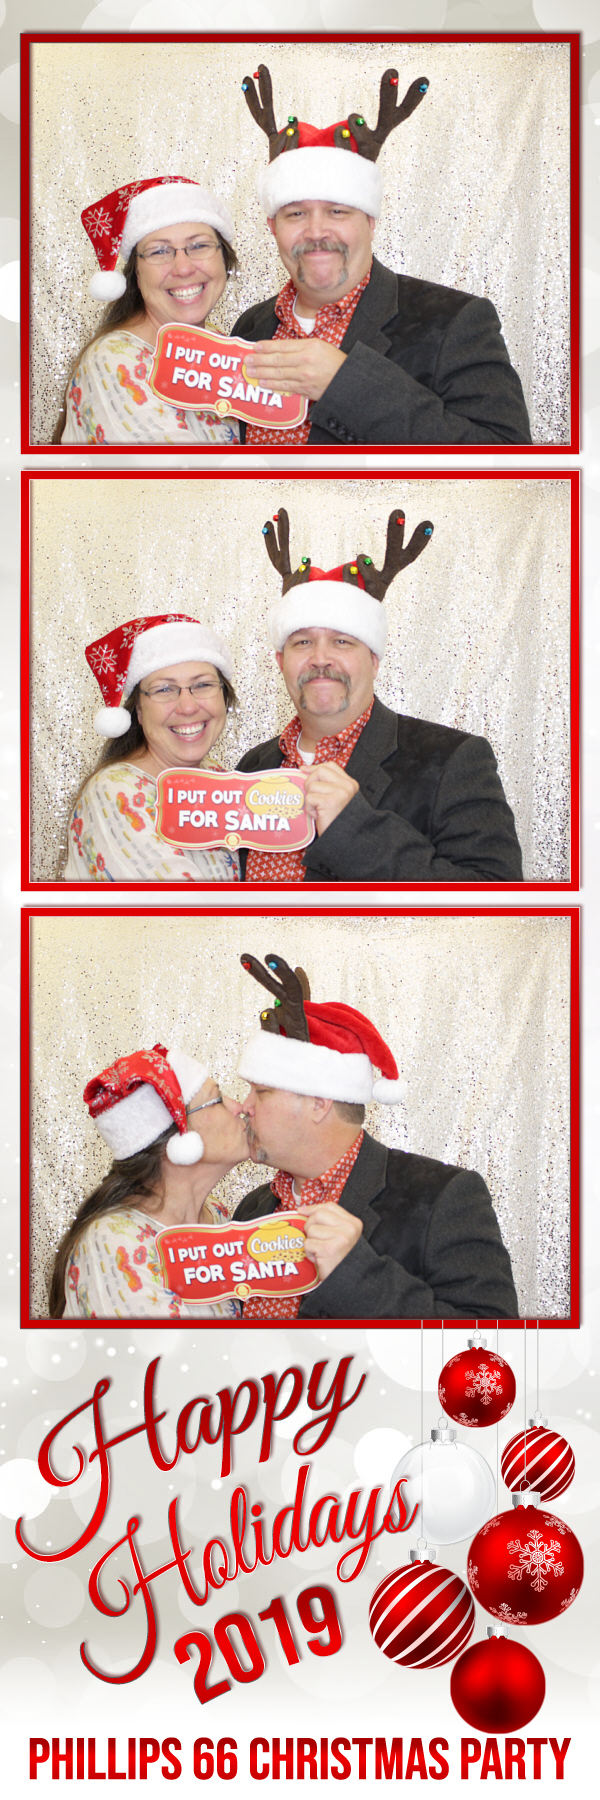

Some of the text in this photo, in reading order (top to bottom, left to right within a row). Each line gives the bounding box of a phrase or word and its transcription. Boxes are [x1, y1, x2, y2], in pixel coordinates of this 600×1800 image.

[165, 342, 241, 371] I PUT OUT
[172, 366, 283, 409] FOR SANTA
[168, 787, 301, 806] I PUT OUT Cookies
[178, 810, 291, 831] FOR SANTA
[168, 1235, 304, 1263] I PUT OUT Cookies
[183, 1260, 299, 1285] FOR SANTA
